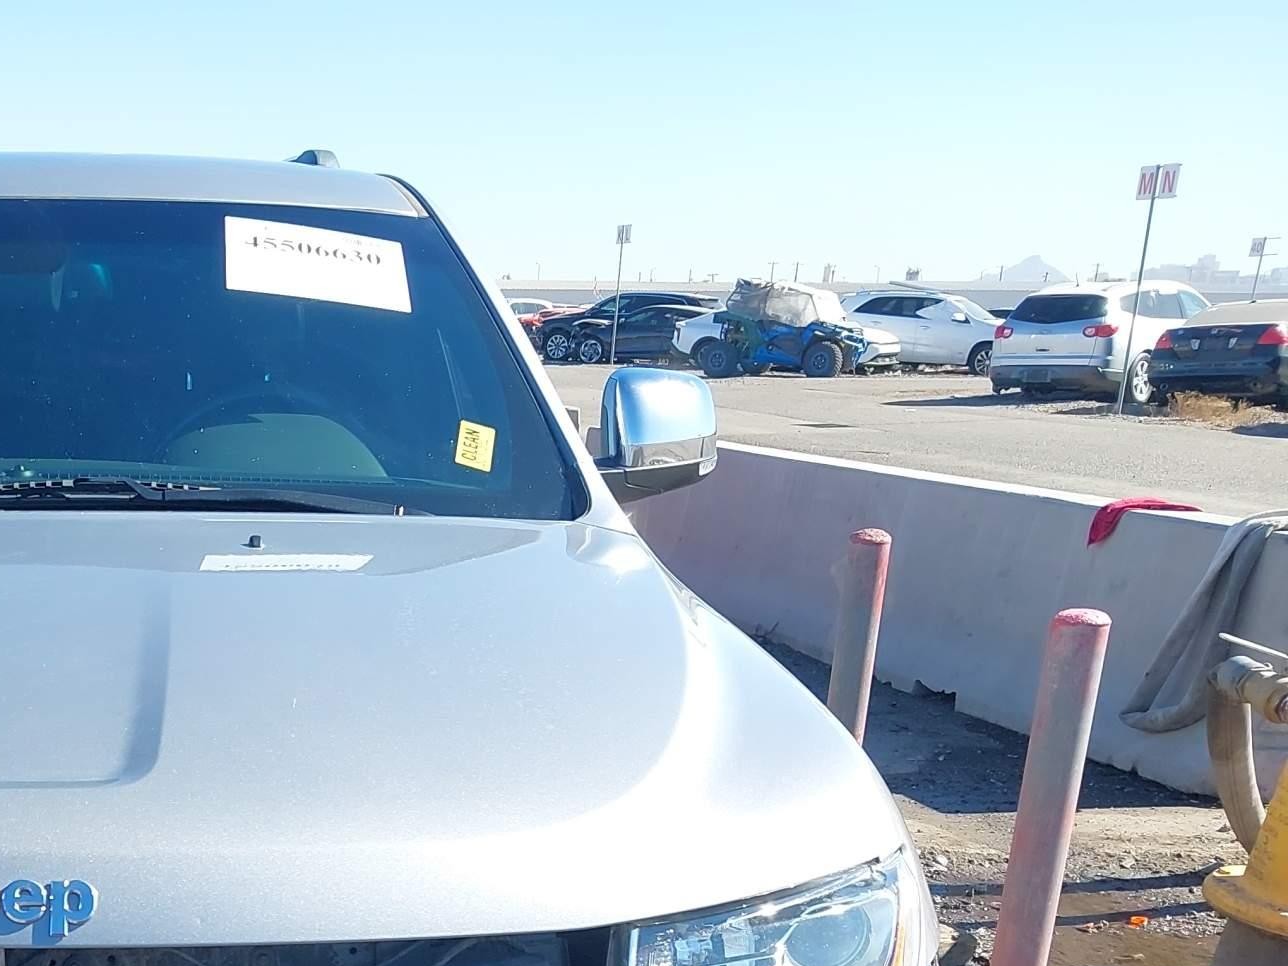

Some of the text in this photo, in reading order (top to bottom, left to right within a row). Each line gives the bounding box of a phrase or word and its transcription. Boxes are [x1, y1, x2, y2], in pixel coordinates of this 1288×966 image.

[1138, 171, 1154, 195] M
[1161, 170, 1176, 194] N
[244, 236, 382, 265] 45506630
[460, 427, 480, 461] CLEAN
